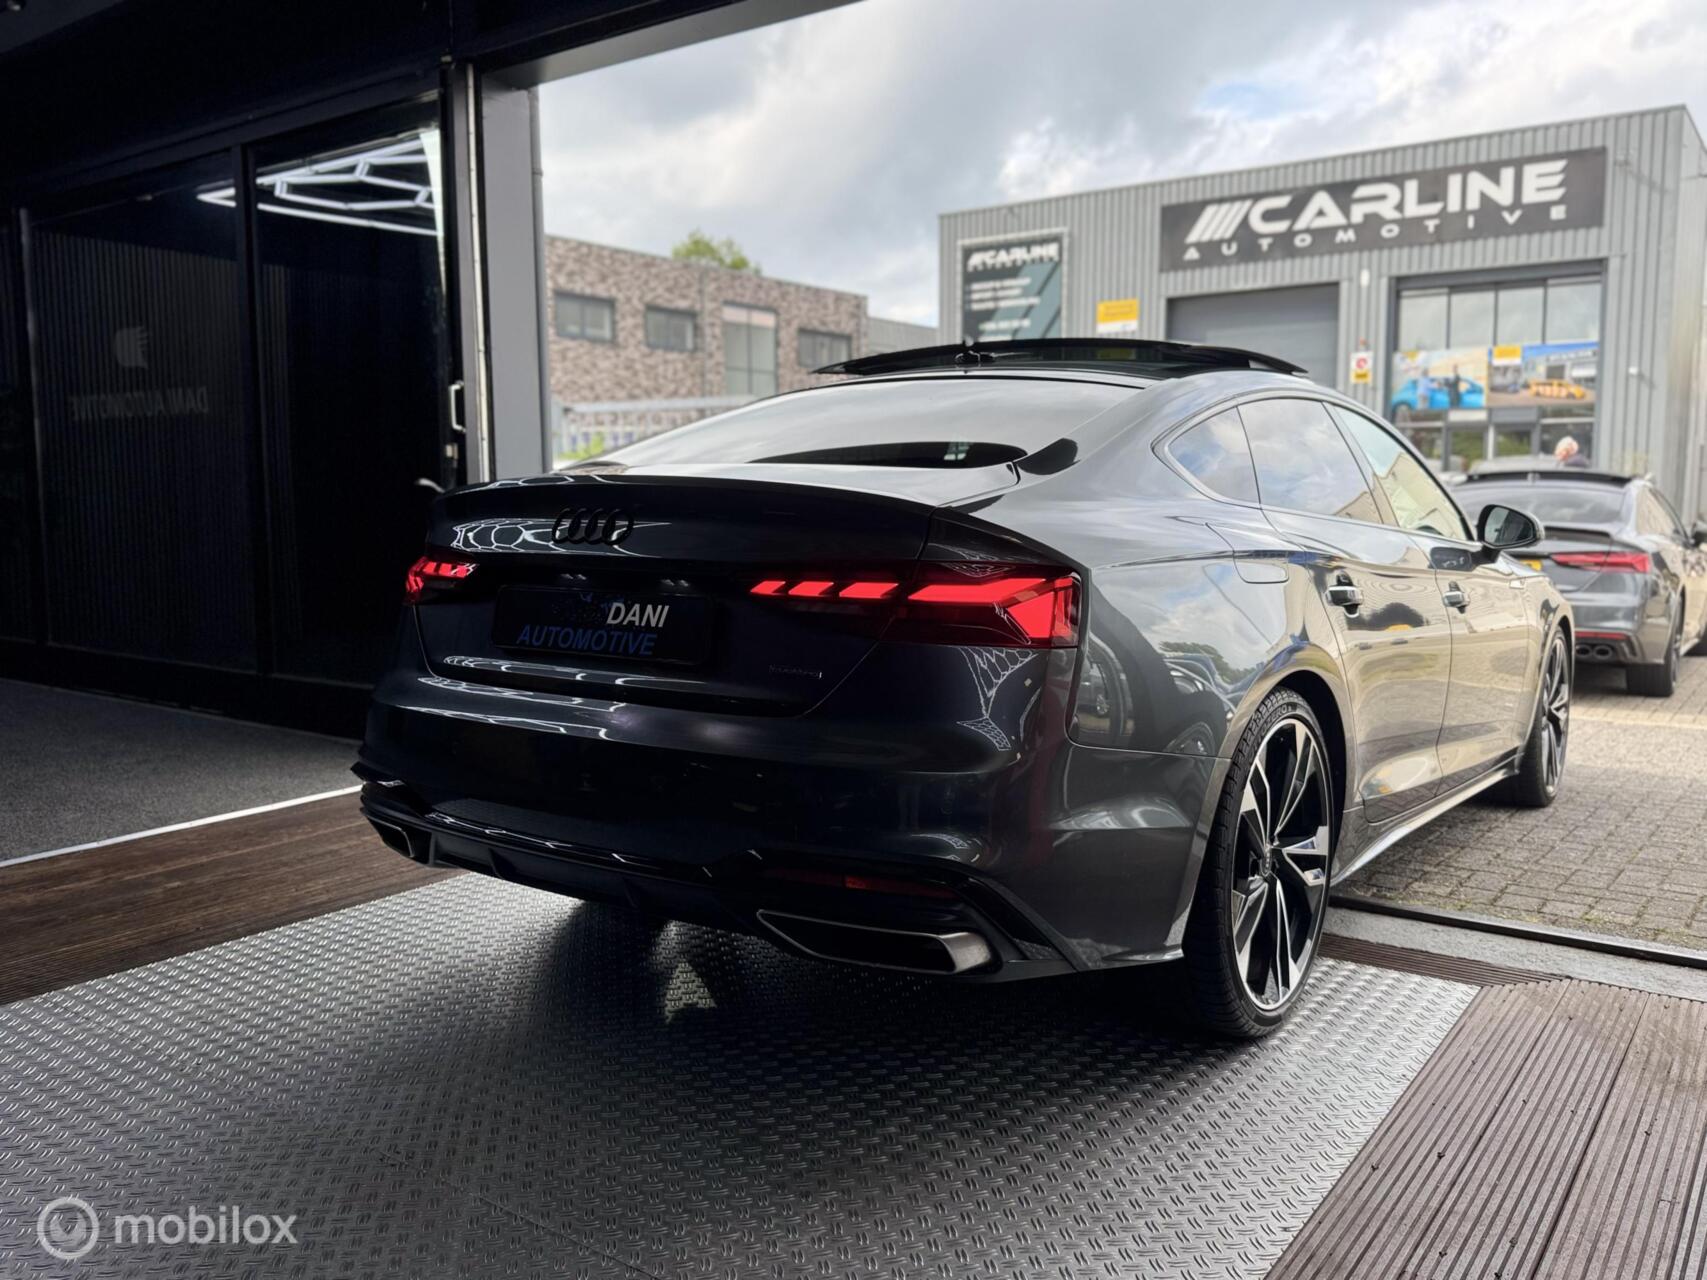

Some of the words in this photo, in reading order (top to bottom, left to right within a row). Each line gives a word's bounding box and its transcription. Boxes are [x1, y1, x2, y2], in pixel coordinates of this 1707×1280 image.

[1248, 159, 1568, 235] CARLINE
[1183, 204, 1567, 261] AUTOMOTIVE
[606, 602, 670, 628] DANI
[516, 624, 658, 656] AUTOMOTIVE
